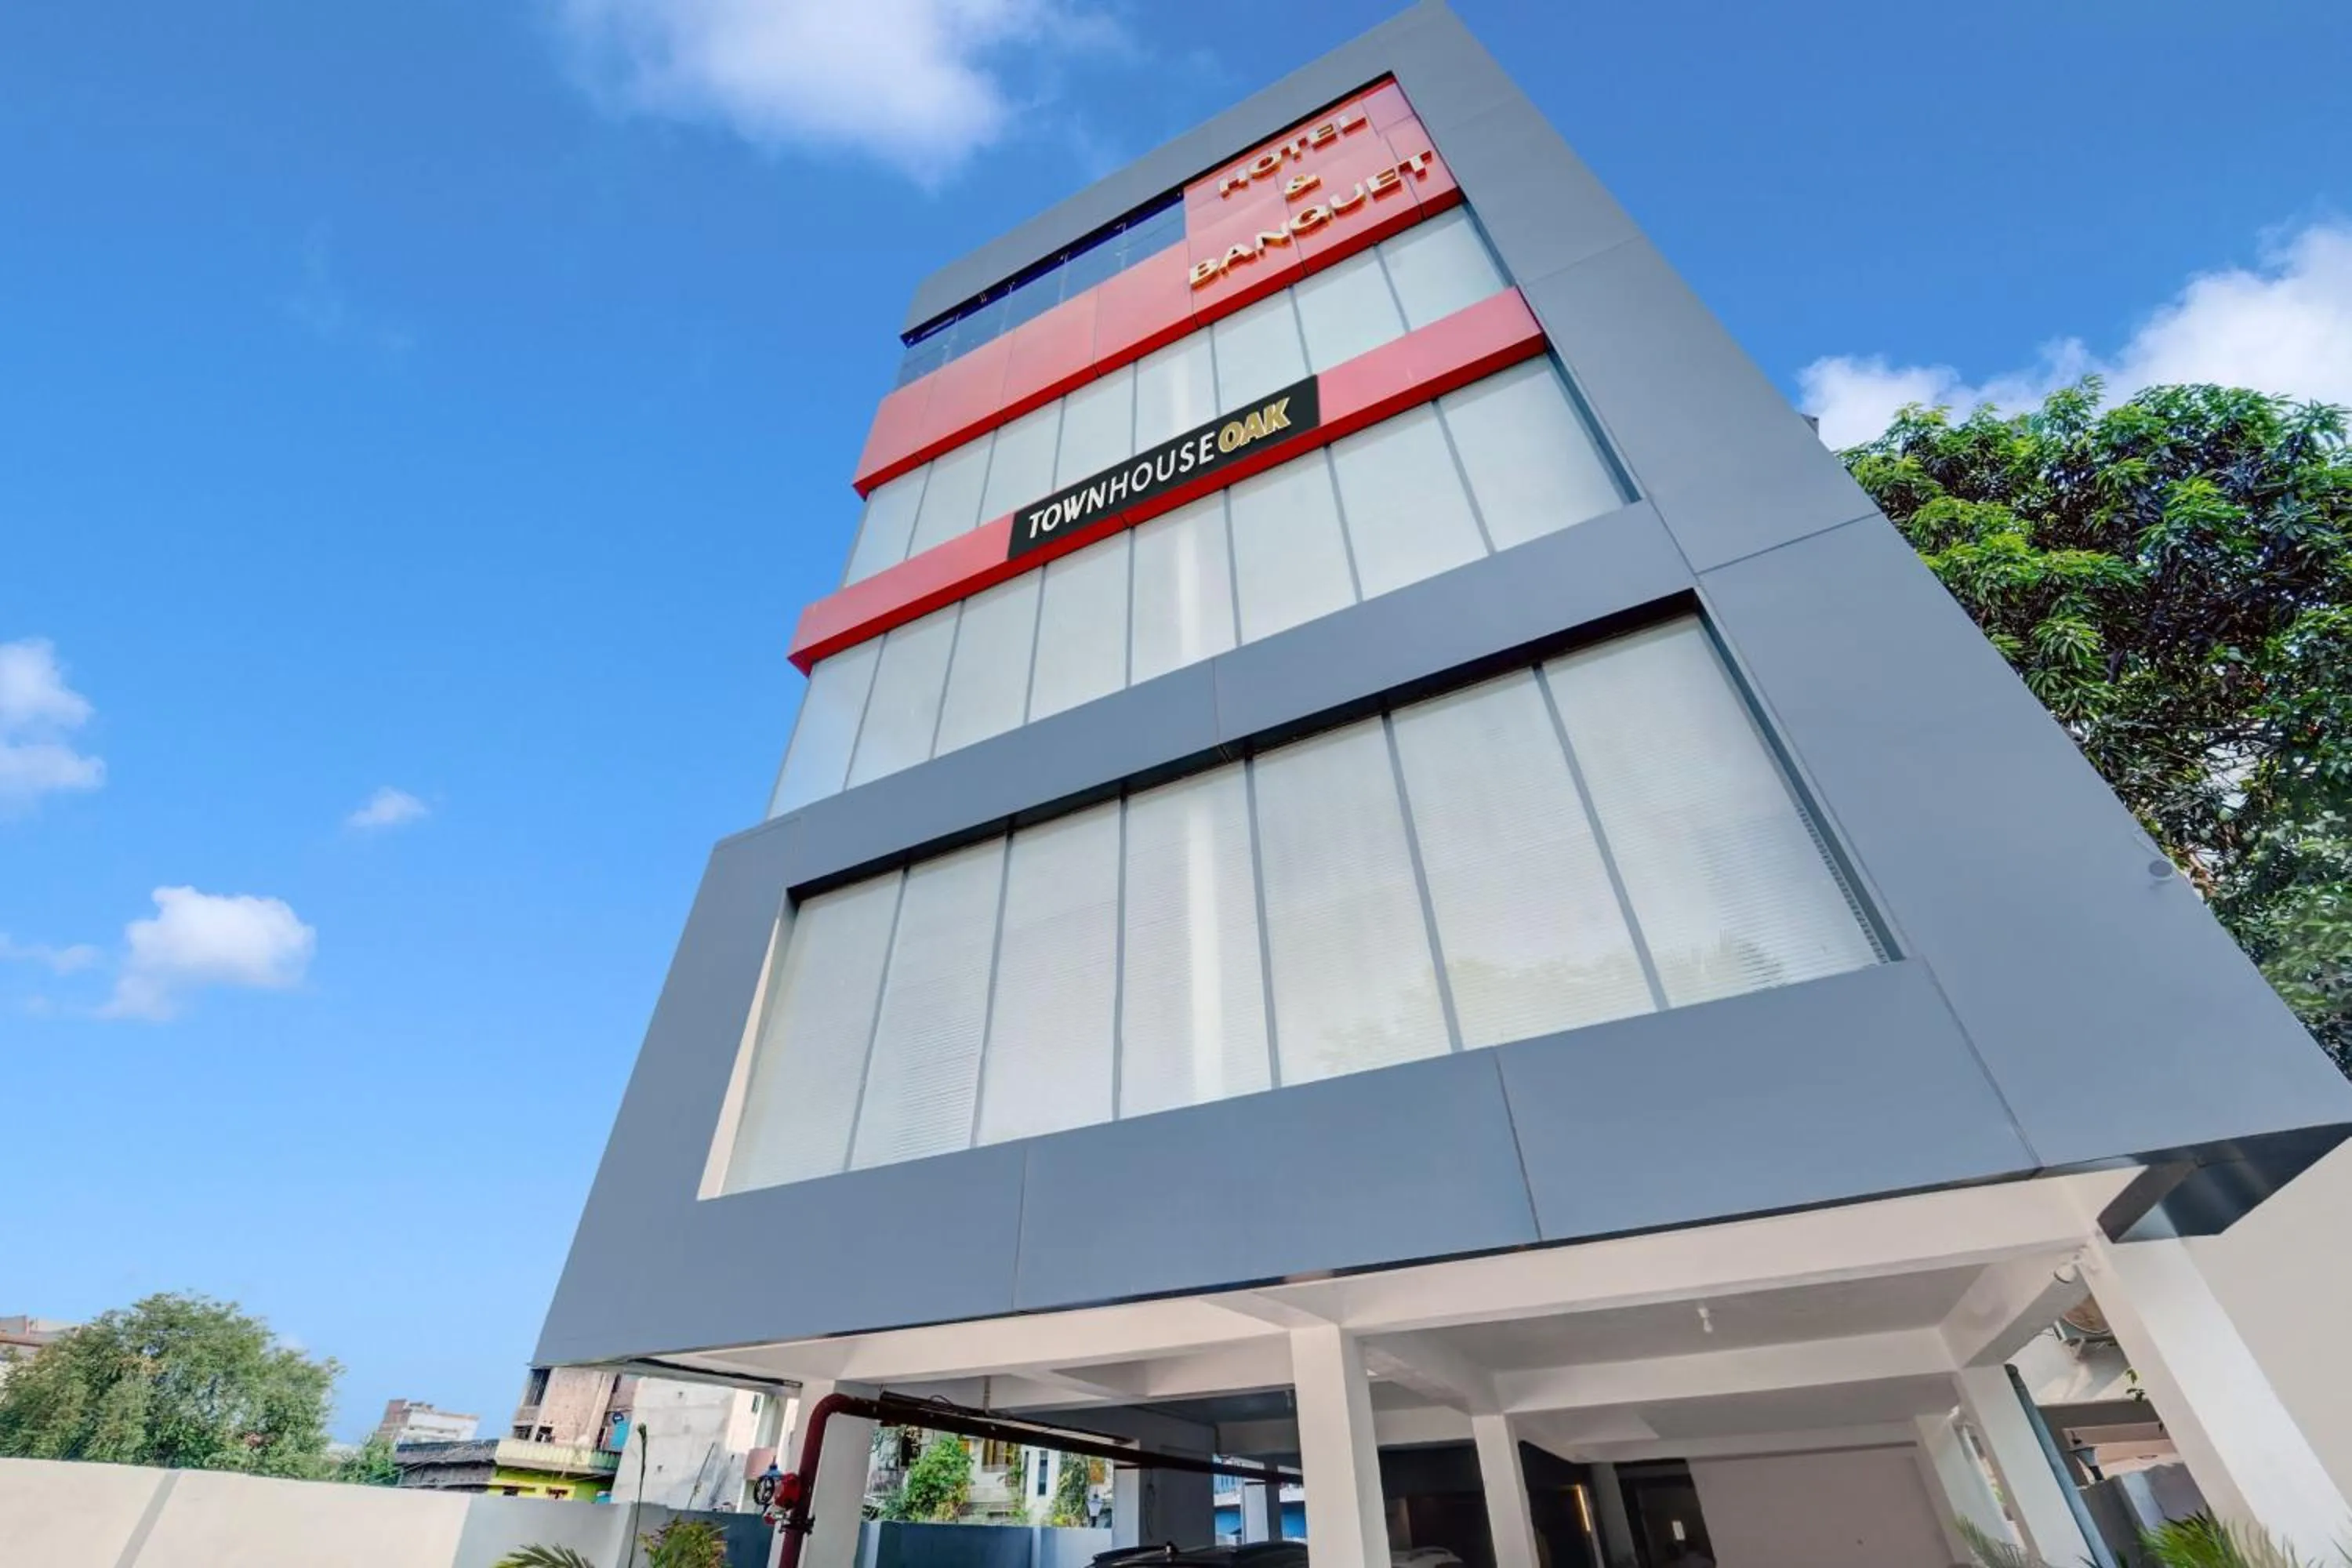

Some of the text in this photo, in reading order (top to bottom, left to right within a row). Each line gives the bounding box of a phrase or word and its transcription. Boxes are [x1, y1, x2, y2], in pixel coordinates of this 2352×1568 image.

[1218, 115, 1367, 198] HOTEL
[1284, 174, 1322, 203] &
[1189, 150, 1433, 291] BANQUET
[1029, 397, 1291, 539] TOWNHOUSE OAK
